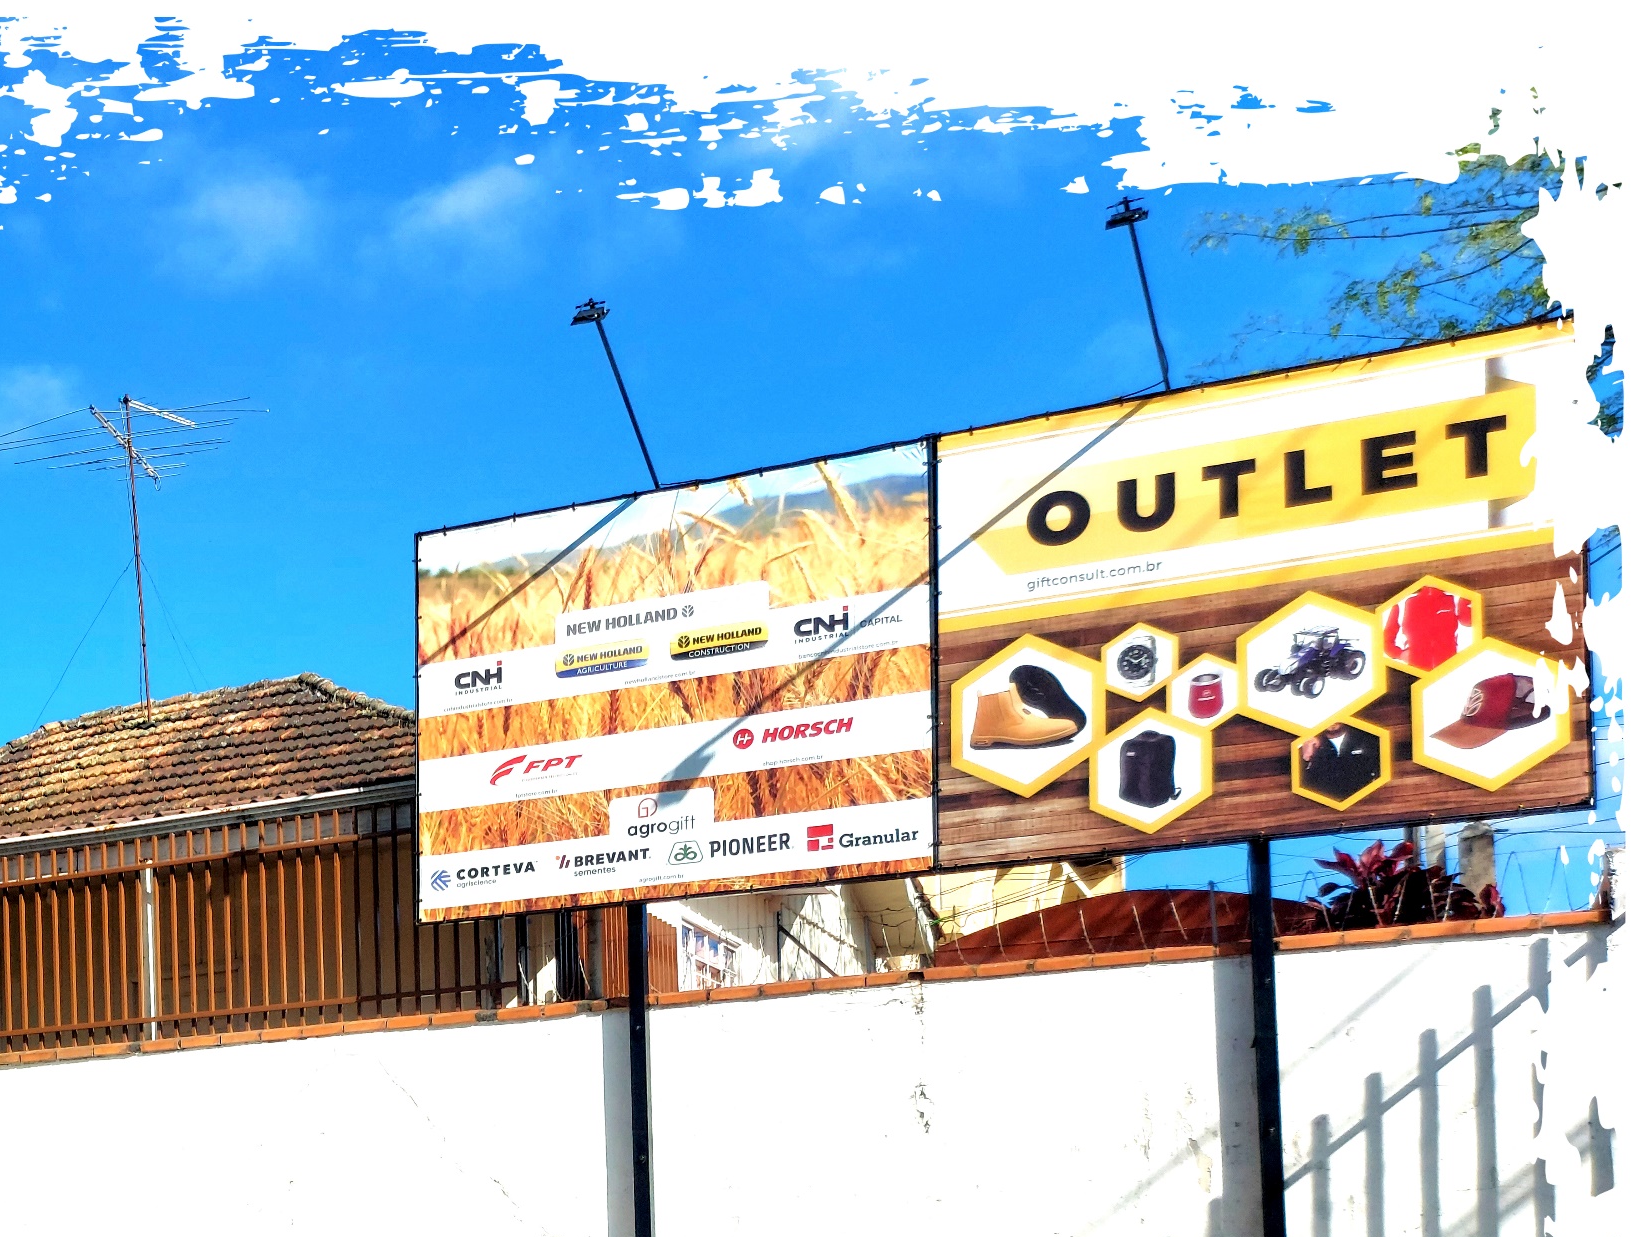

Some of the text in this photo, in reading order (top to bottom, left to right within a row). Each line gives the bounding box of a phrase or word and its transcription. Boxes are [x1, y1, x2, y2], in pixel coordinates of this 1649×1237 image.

[1026, 415, 1506, 546] OUTLET
[1027, 560, 1162, 592] giftconsult.com.br
[566, 607, 677, 636] NEW HOLLAND
[860, 615, 903, 628] CAPITAL
[692, 627, 762, 645] NEW HOLLAND
[794, 632, 849, 644] INDUSTRIAL
[576, 646, 643, 663] NEW HOLLAND
[688, 642, 750, 658] CONSTRUCTION
[576, 661, 628, 675] AGRICULTURE
[455, 685, 502, 696] INDUSTRIAL
[761, 717, 854, 744] HORSCH
[523, 754, 583, 775] FPT
[627, 815, 696, 838] agrogift
[709, 832, 791, 858] PIONEER
[838, 829, 919, 848] Granular
[574, 848, 650, 868] BREVANT
[456, 861, 536, 881] CORTEVA
[573, 866, 616, 877] sementes
[456, 878, 497, 888] agriscience
